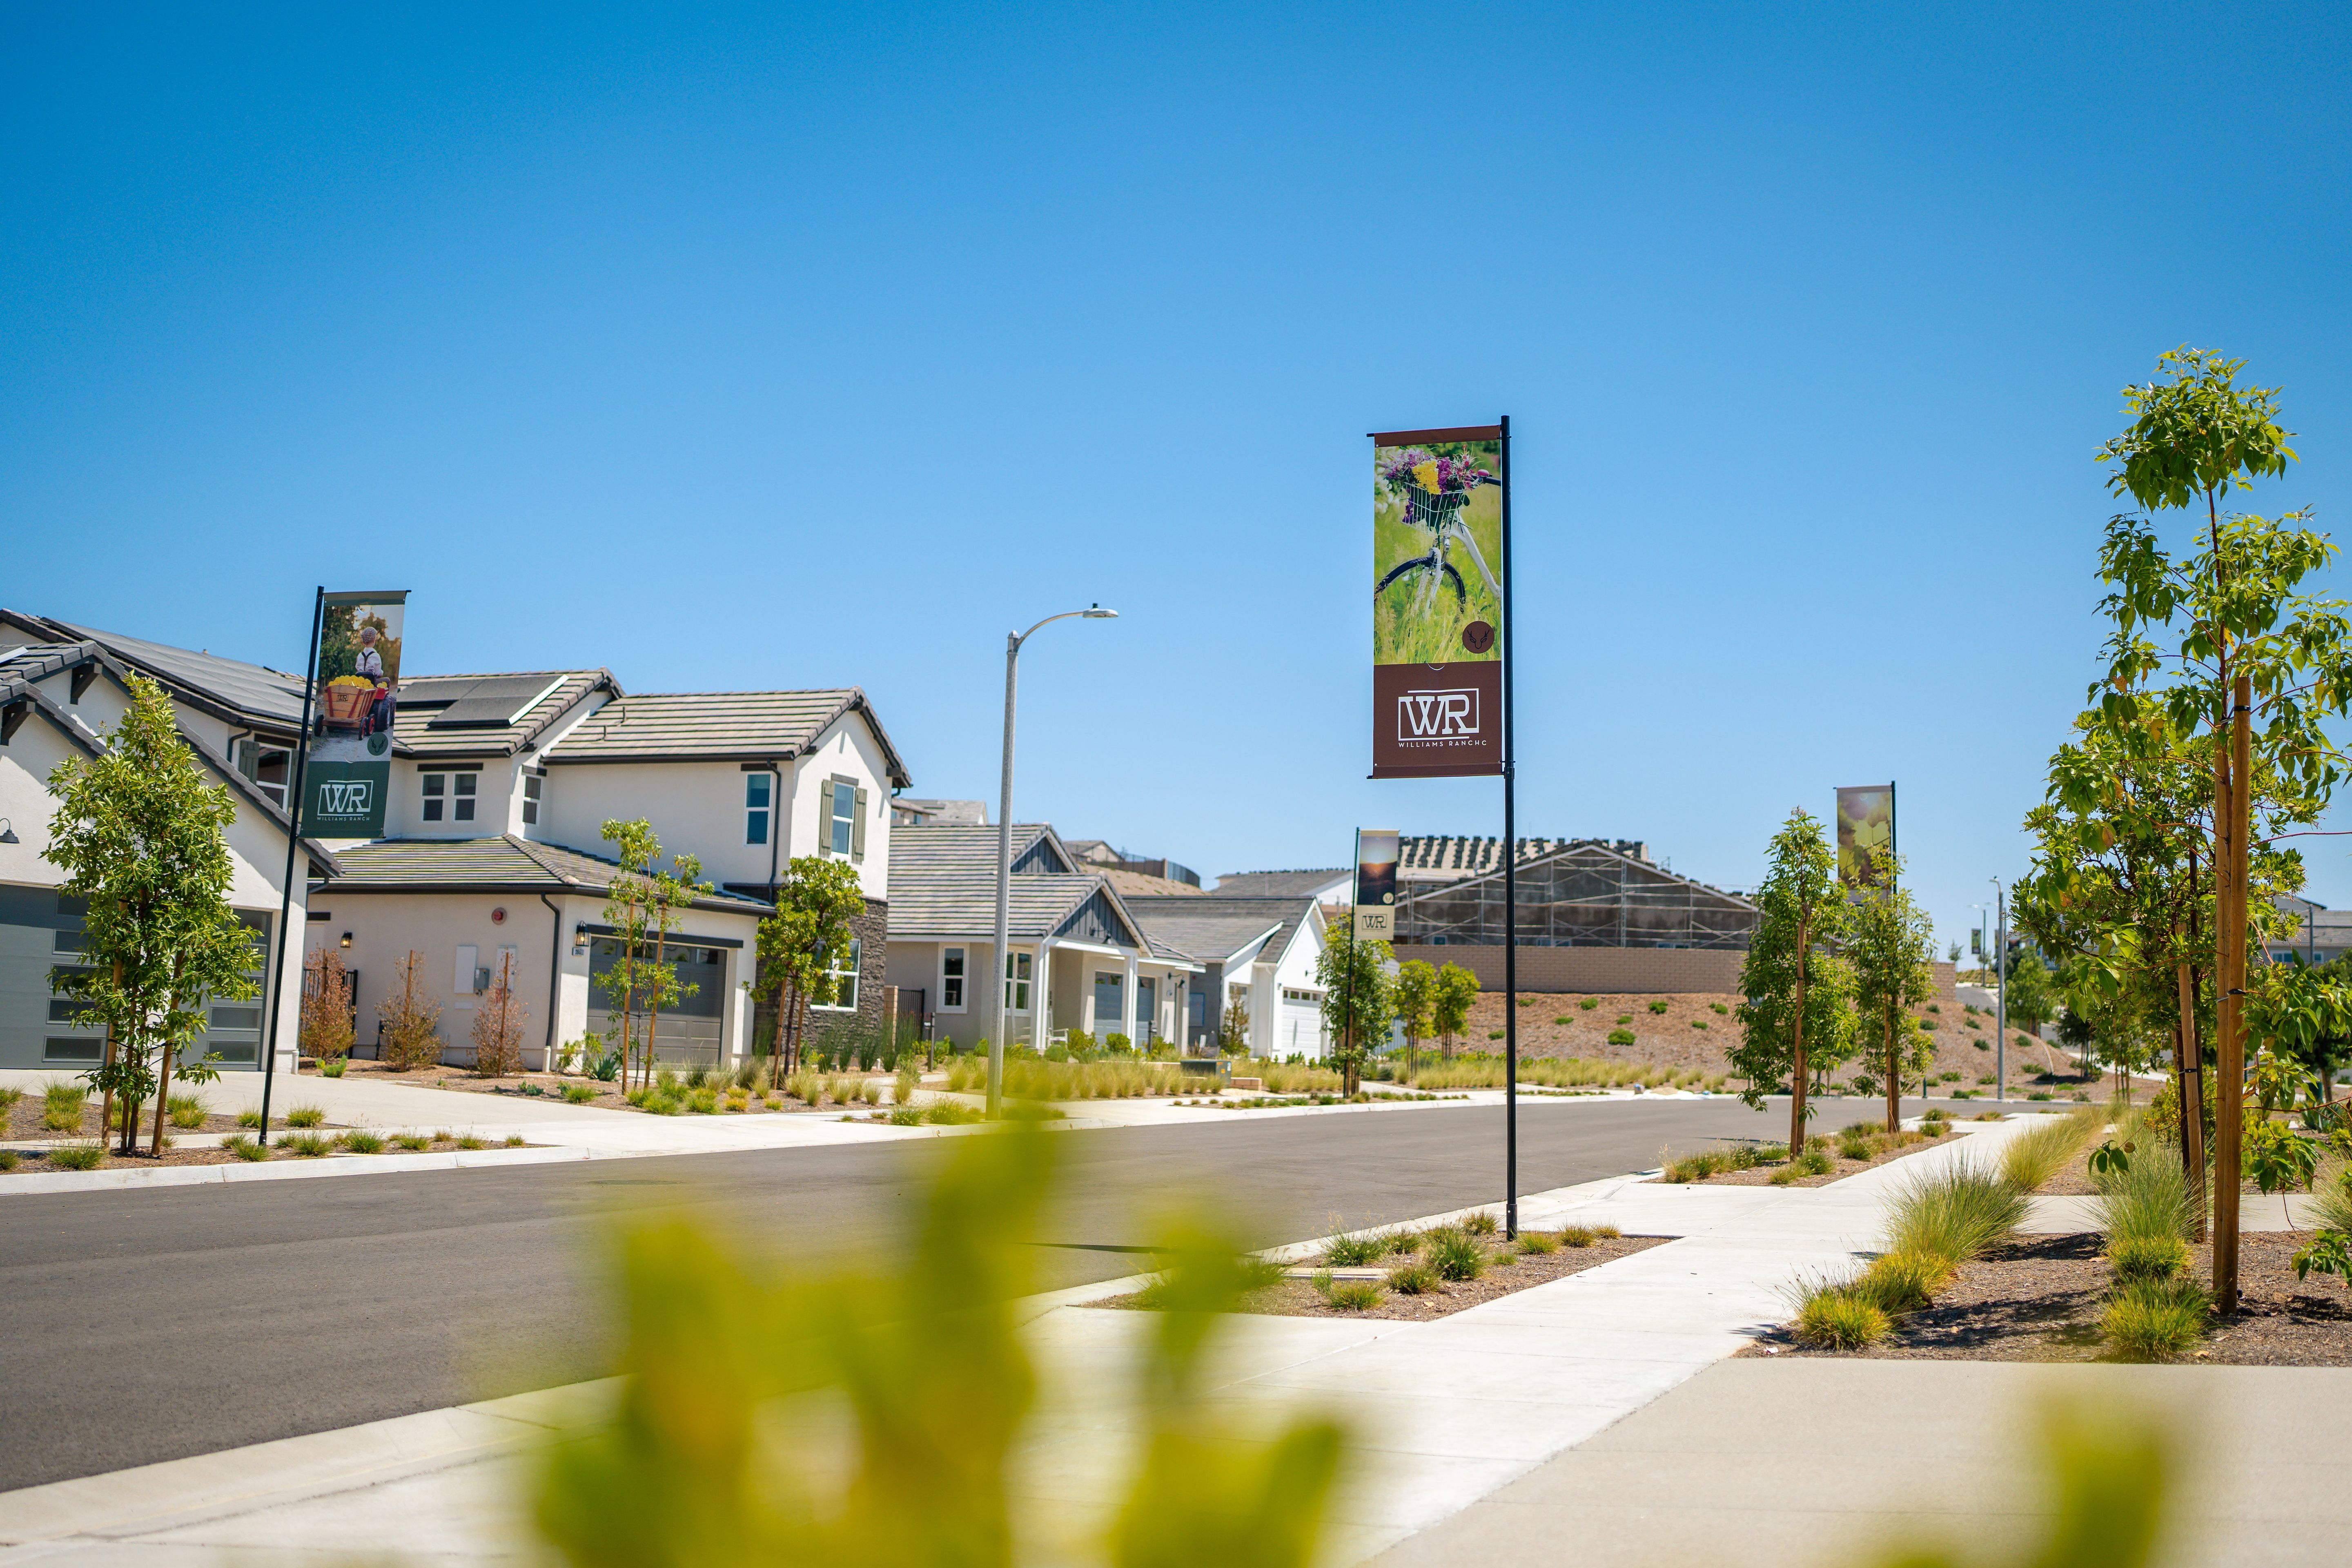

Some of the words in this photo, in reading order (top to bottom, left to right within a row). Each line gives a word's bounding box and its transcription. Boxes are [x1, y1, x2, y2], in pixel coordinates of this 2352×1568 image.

[1398, 694, 1479, 735] WR
[320, 784, 371, 813] WR
[1362, 915, 1386, 928] WR
